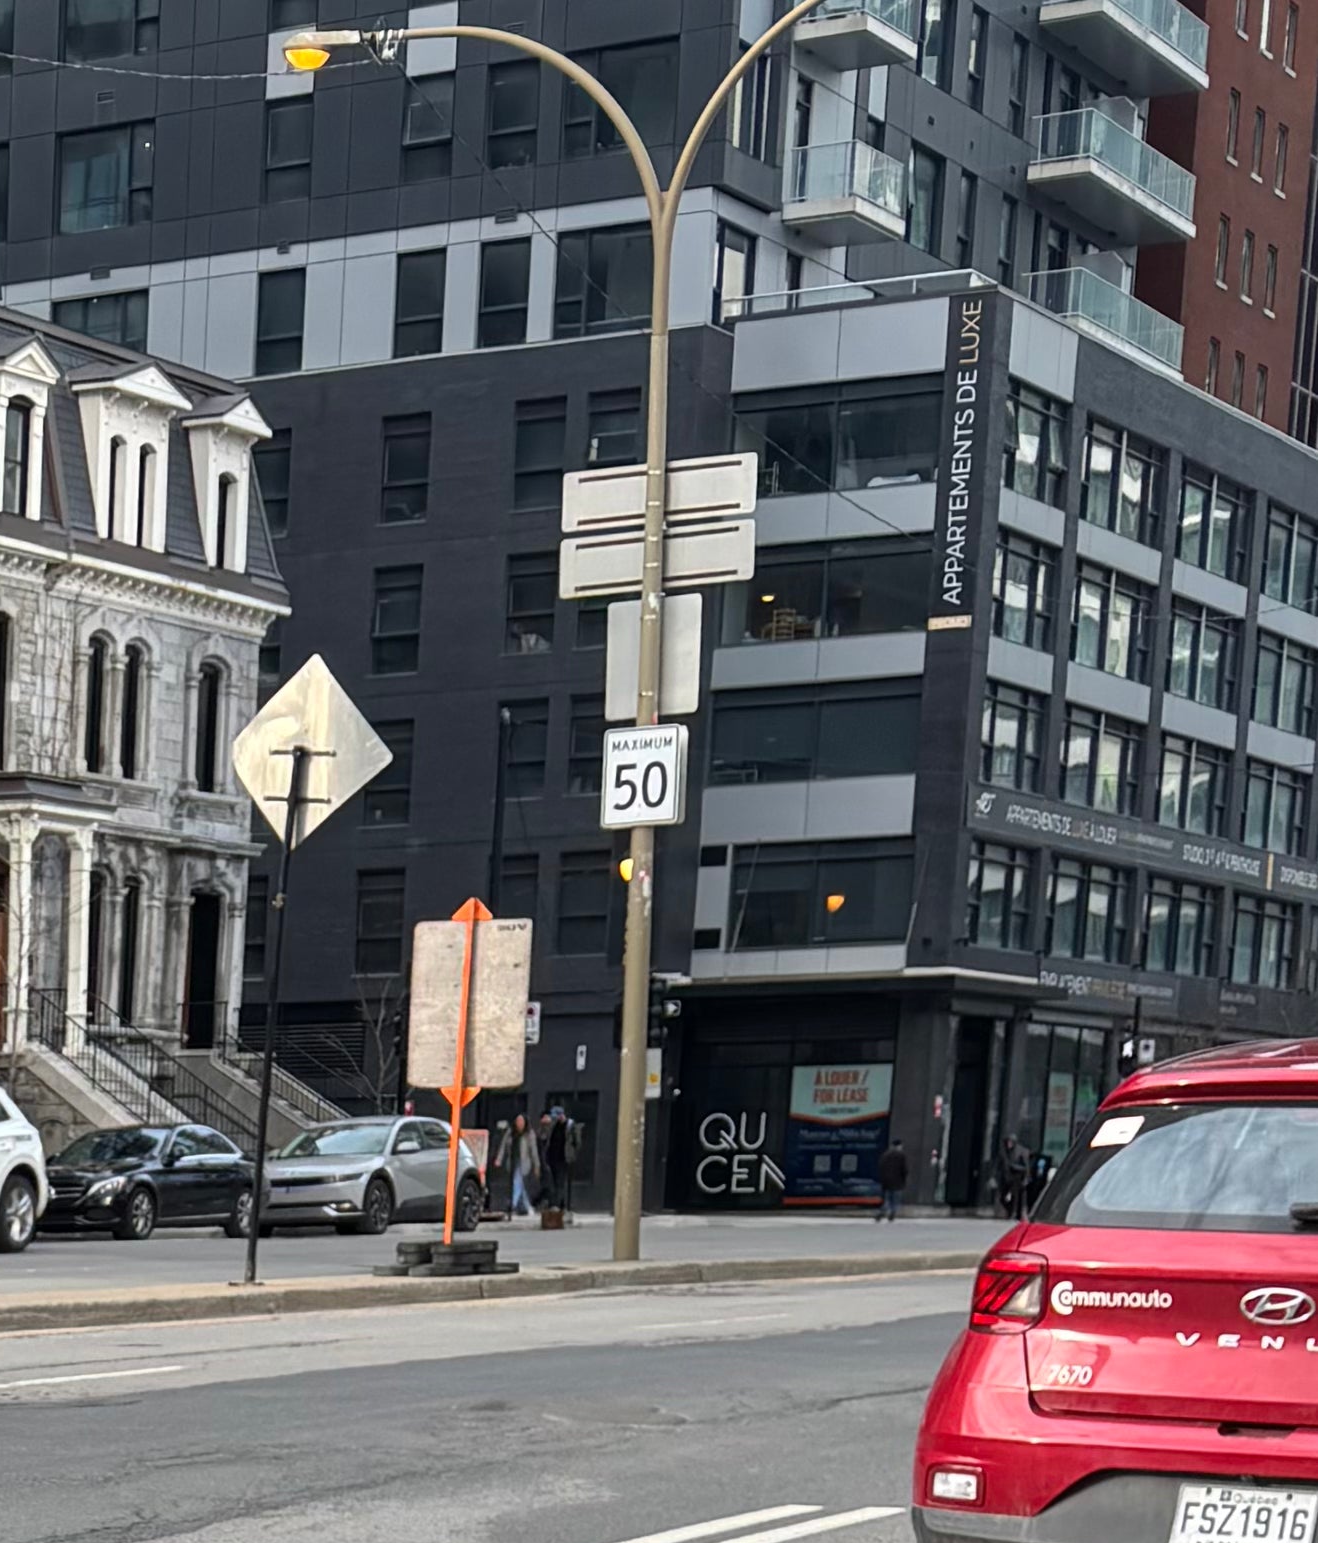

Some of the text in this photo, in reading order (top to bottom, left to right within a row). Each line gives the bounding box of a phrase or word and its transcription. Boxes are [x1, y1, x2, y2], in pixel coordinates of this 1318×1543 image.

[958, 299, 982, 366] LUXE
[956, 369, 978, 403] DE
[942, 408, 975, 605] APPARTEMENTS
[611, 736, 673, 753] MAXIMUM
[612, 760, 669, 811] 50
[1050, 1280, 1173, 1316] Communauto
[1047, 1364, 1094, 1386] 7670
[1179, 1501, 1310, 1541] FSZ1916
